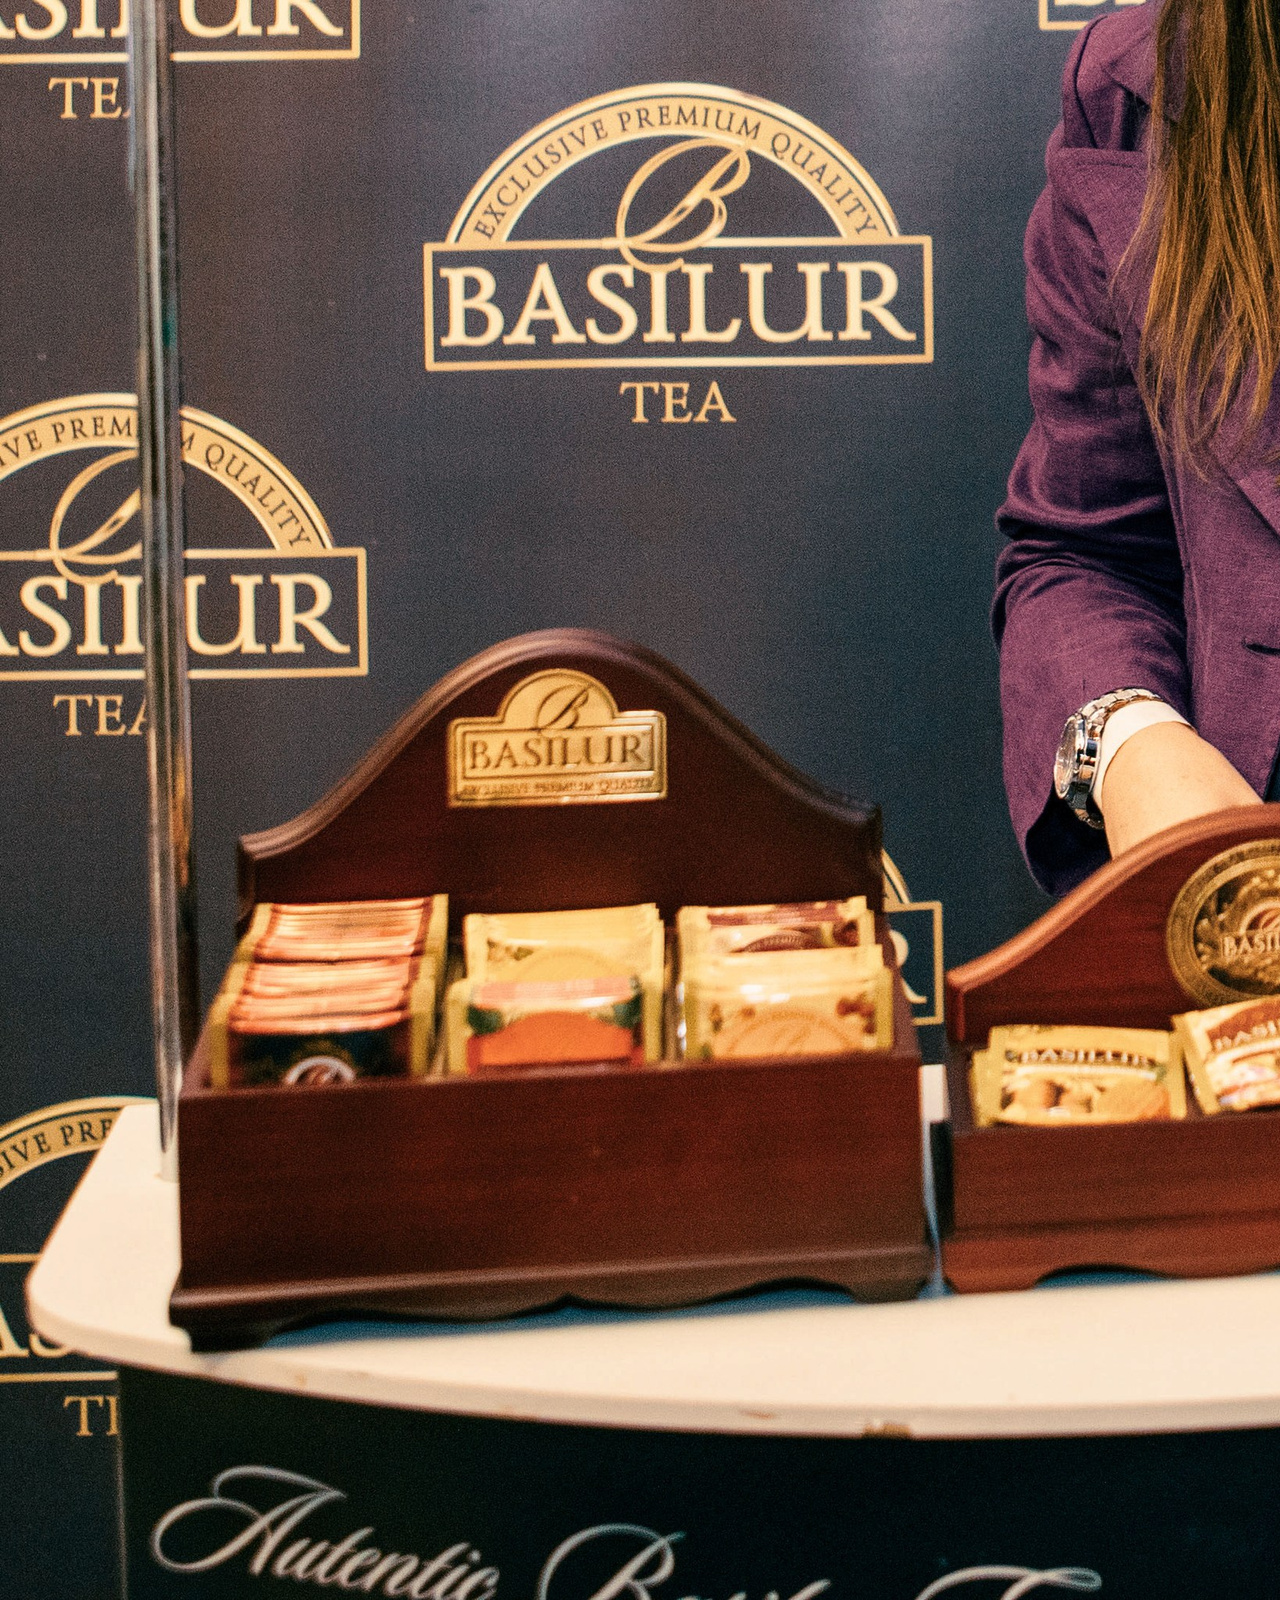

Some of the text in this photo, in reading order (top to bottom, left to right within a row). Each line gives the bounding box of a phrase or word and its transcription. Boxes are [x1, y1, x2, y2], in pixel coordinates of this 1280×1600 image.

[49, 77, 130, 119] TE
[472, 105, 878, 240] EXCLUSIVE PREMIUM QUALITY
[439, 261, 916, 347] BASILUR
[619, 381, 736, 423] TEA
[204, 443, 311, 548] QUALITY
[470, 733, 645, 770] BASILUR
